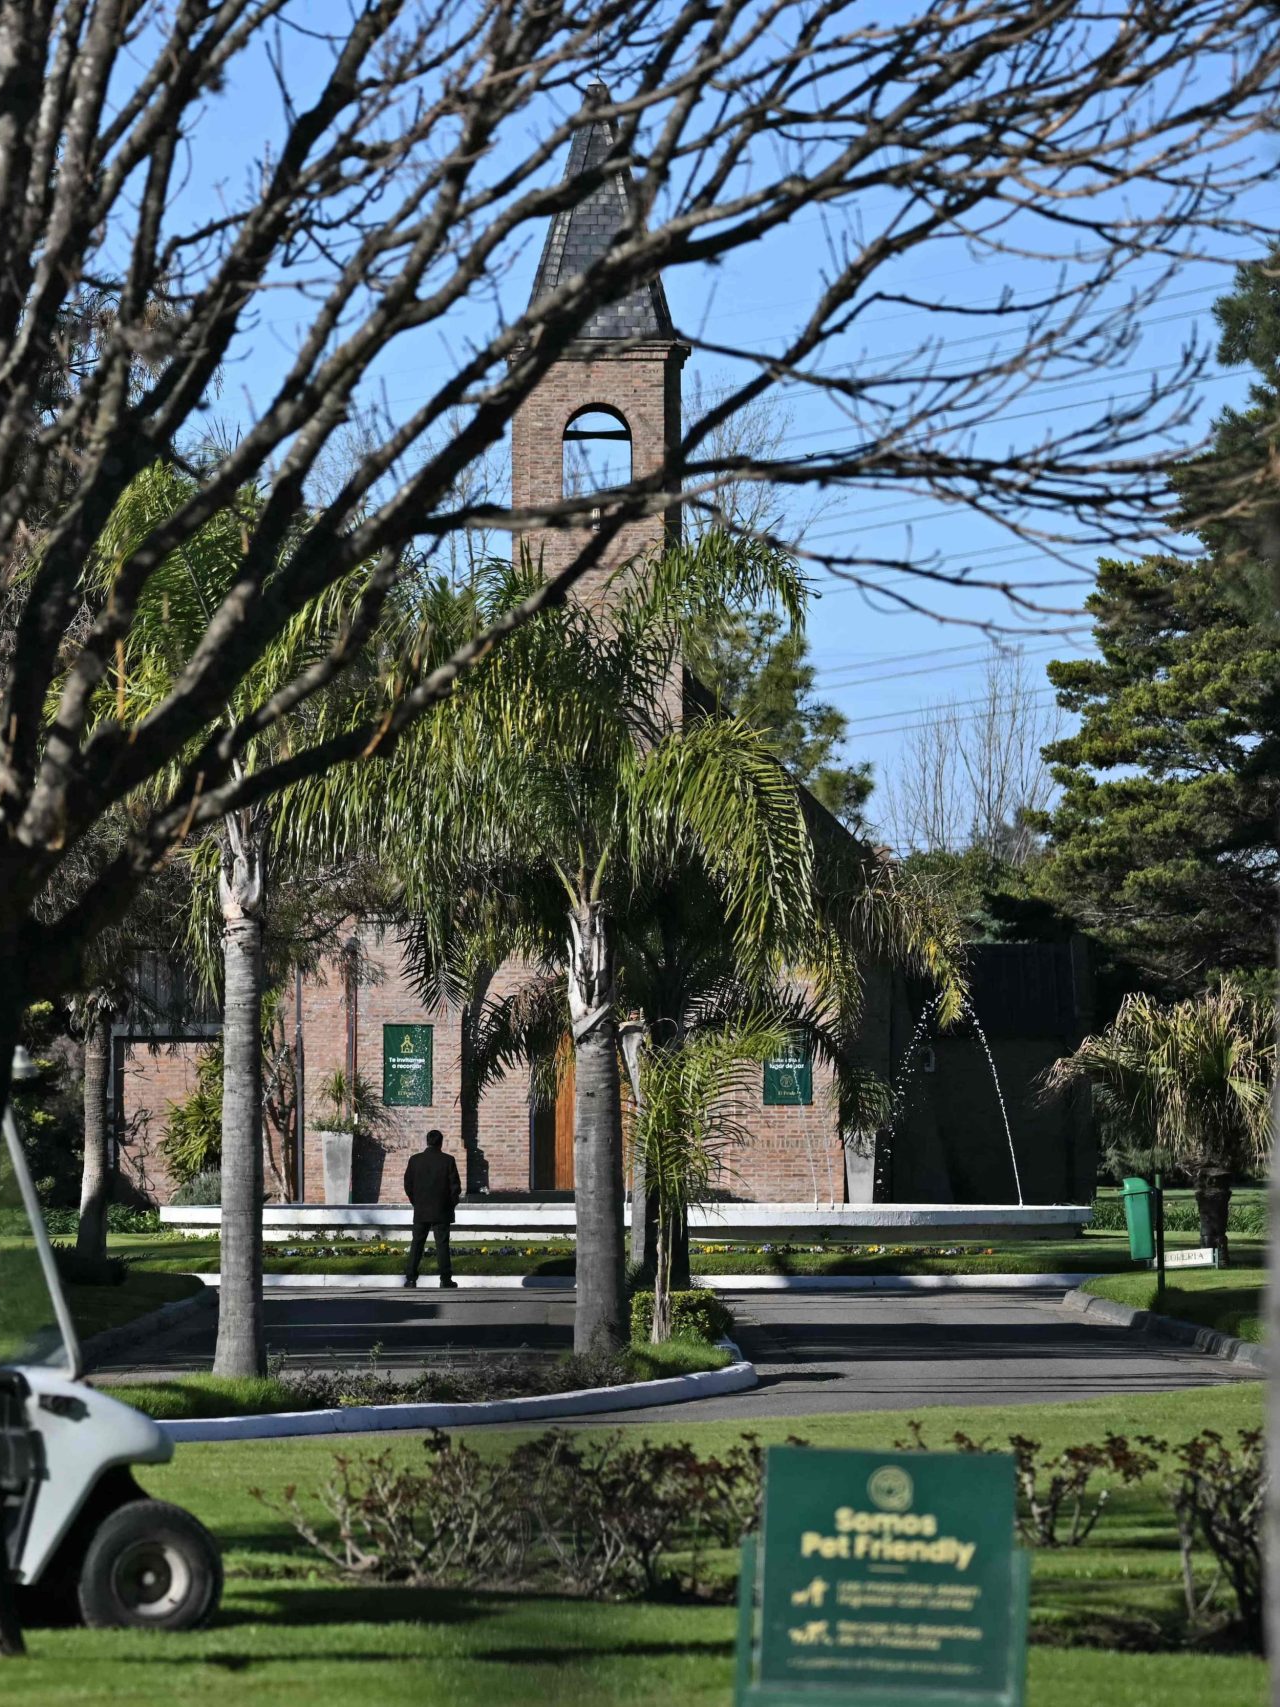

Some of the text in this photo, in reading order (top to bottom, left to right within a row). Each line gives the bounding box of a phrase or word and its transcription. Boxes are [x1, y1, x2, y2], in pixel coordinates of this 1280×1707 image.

[835, 1507, 937, 1536] Somos
[801, 1532, 976, 1571] Pet Friendly
